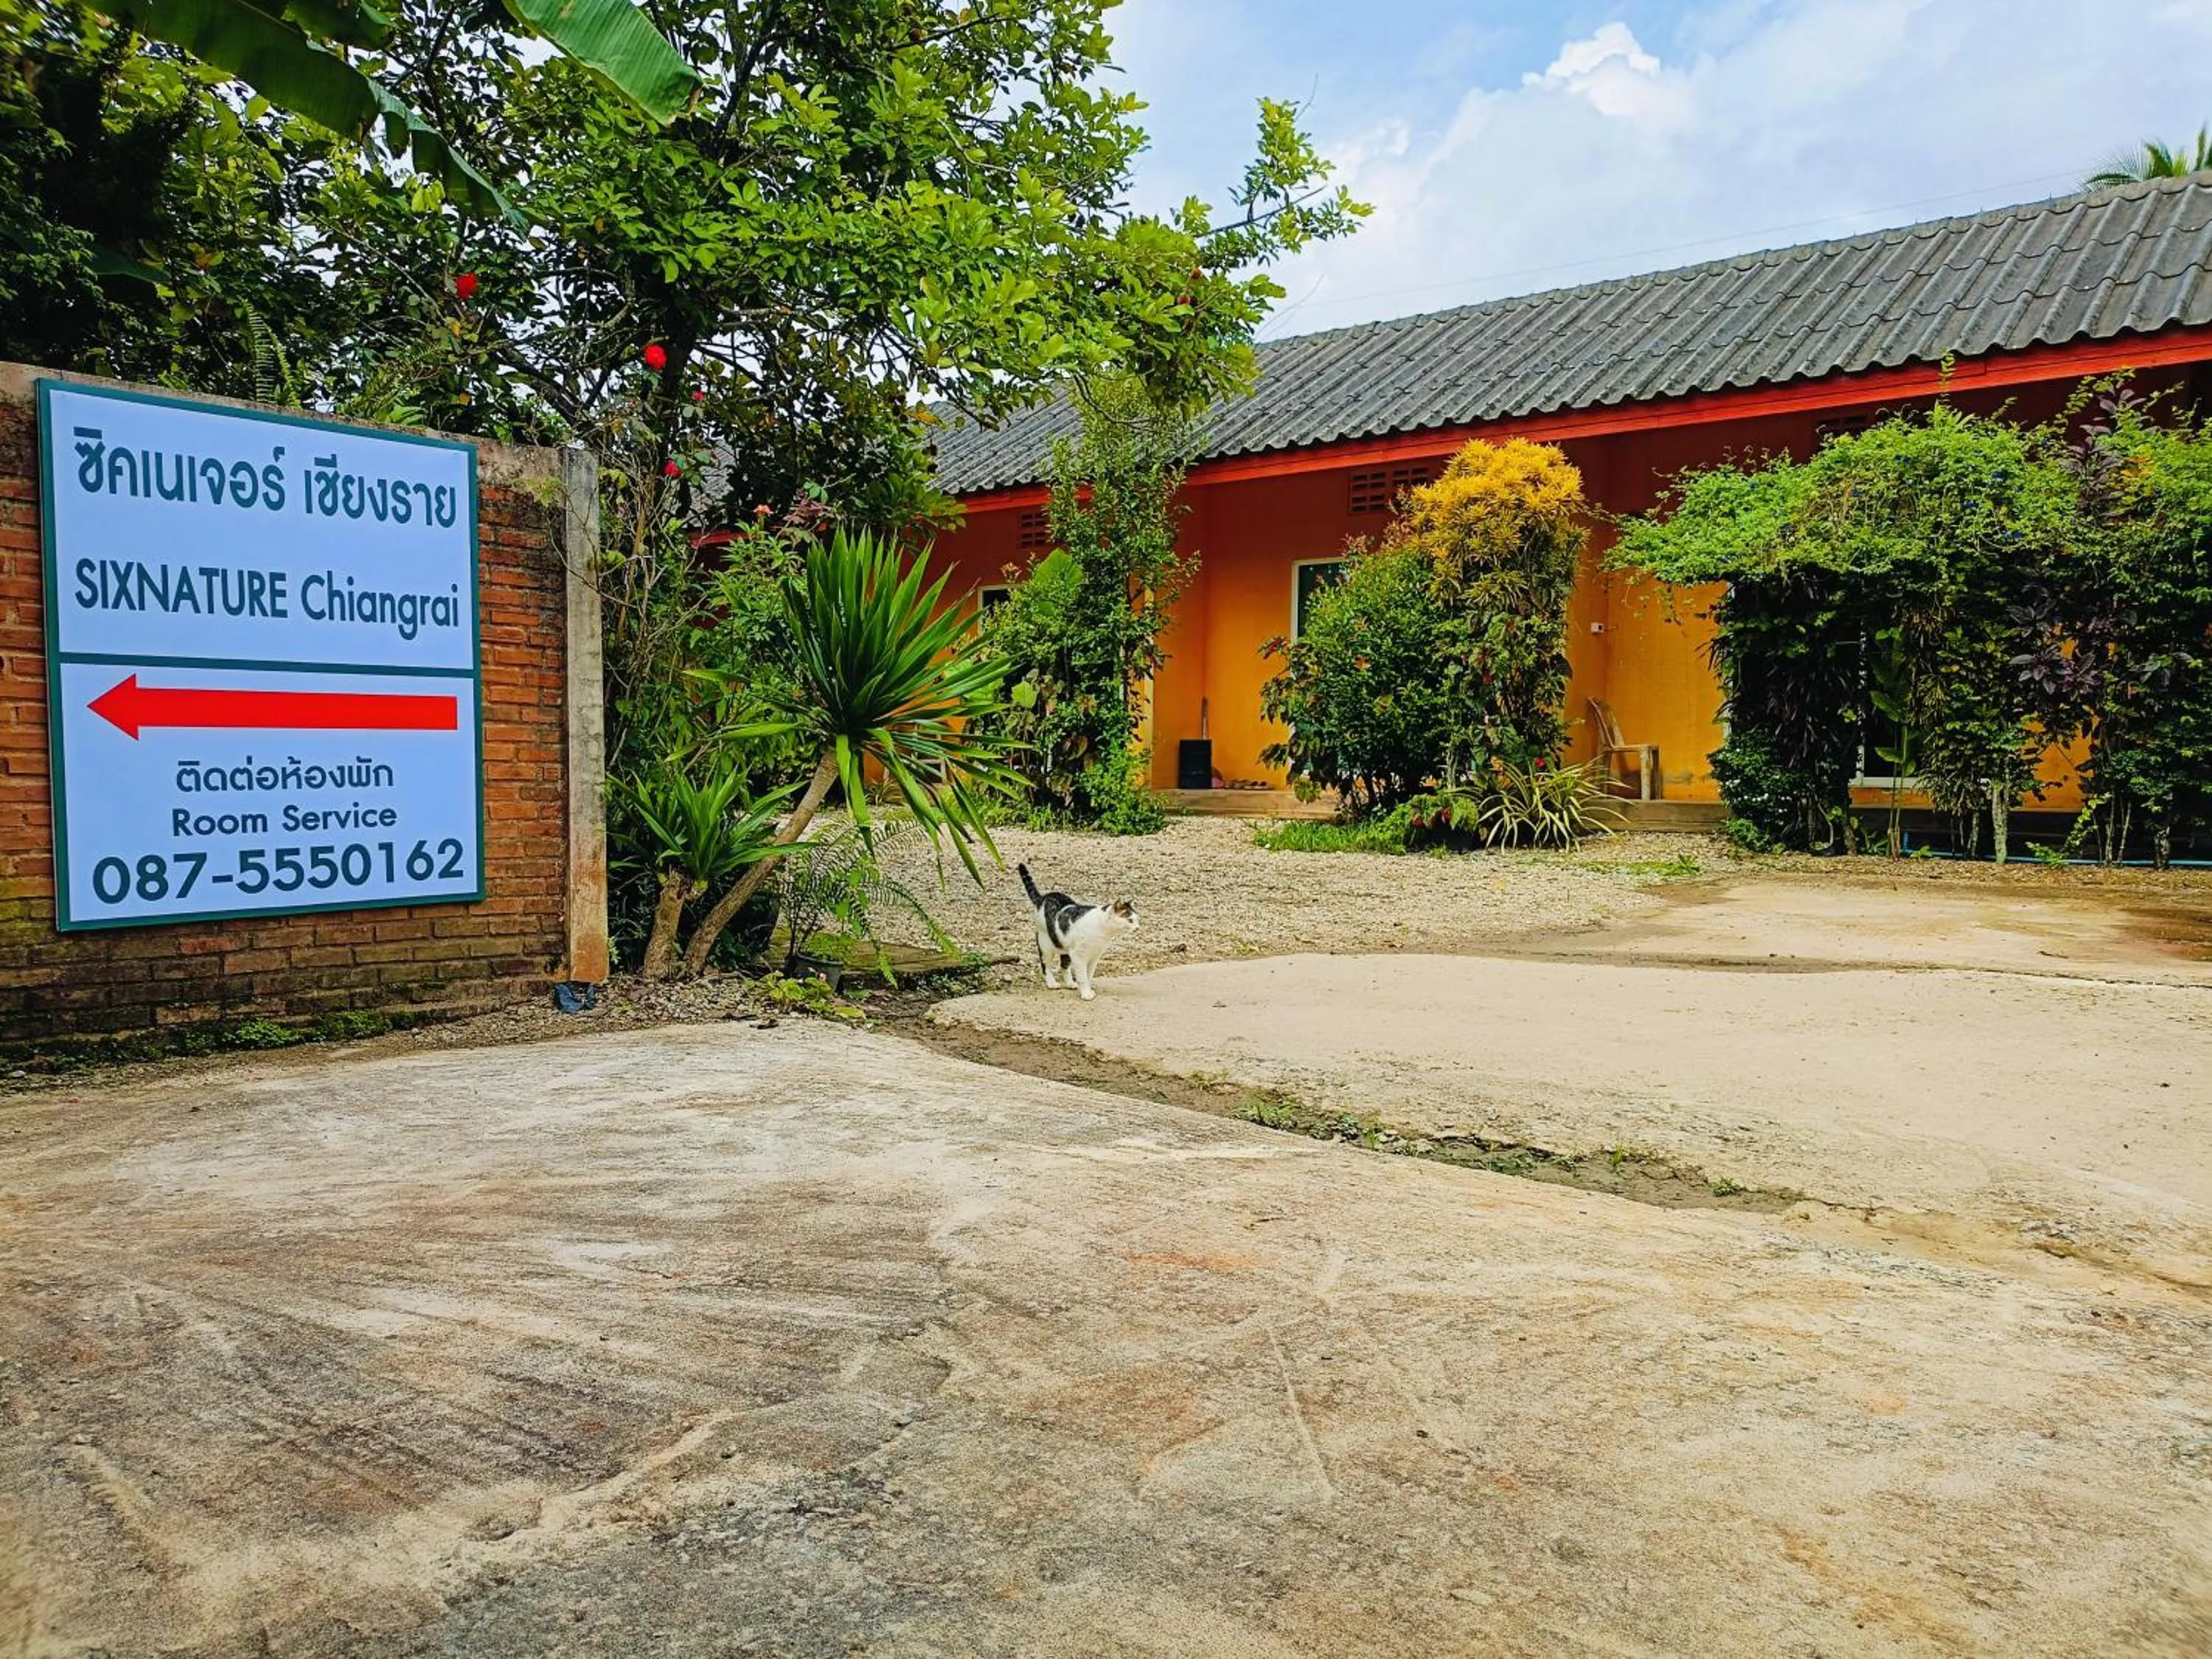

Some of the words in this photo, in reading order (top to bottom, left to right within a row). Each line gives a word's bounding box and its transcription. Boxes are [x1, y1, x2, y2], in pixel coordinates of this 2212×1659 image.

[73, 426, 286, 511] ซิคเนเจอร์
[304, 453, 456, 529] เชียงราย
[74, 557, 288, 619] SIXNATURE
[301, 570, 459, 641] Chiangrai
[175, 754, 394, 793] ติดต่อห้องพัก
[172, 807, 268, 837] Room
[282, 801, 397, 832] Service
[92, 838, 465, 904] 087-5550162
